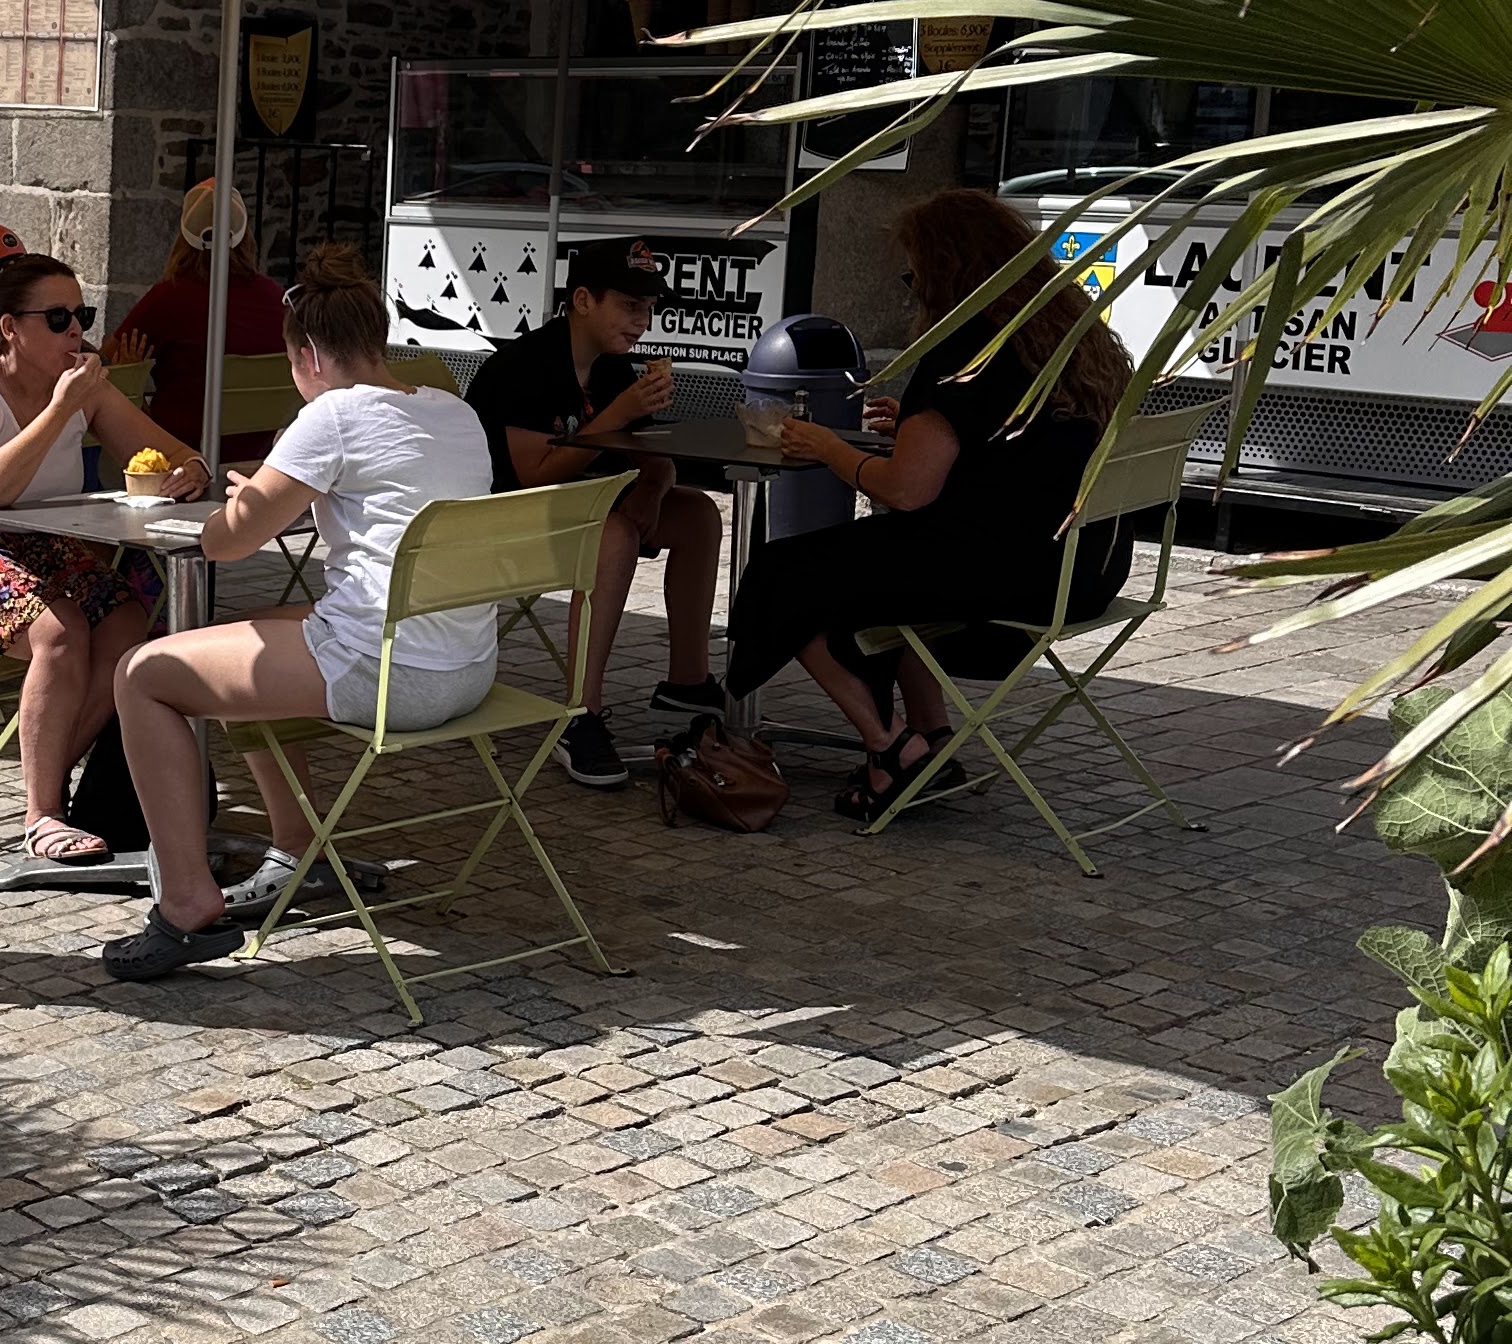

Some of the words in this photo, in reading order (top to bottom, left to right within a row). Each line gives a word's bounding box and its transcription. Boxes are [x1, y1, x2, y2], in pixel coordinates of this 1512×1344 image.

[660, 307, 763, 340] GLACIER
[1198, 302, 1358, 341] ATSAN
[628, 343, 687, 358] ABRICATION
[688, 348, 710, 360] SUR
[711, 349, 744, 363] PLACE
[1197, 337, 1352, 375] GLCIER
